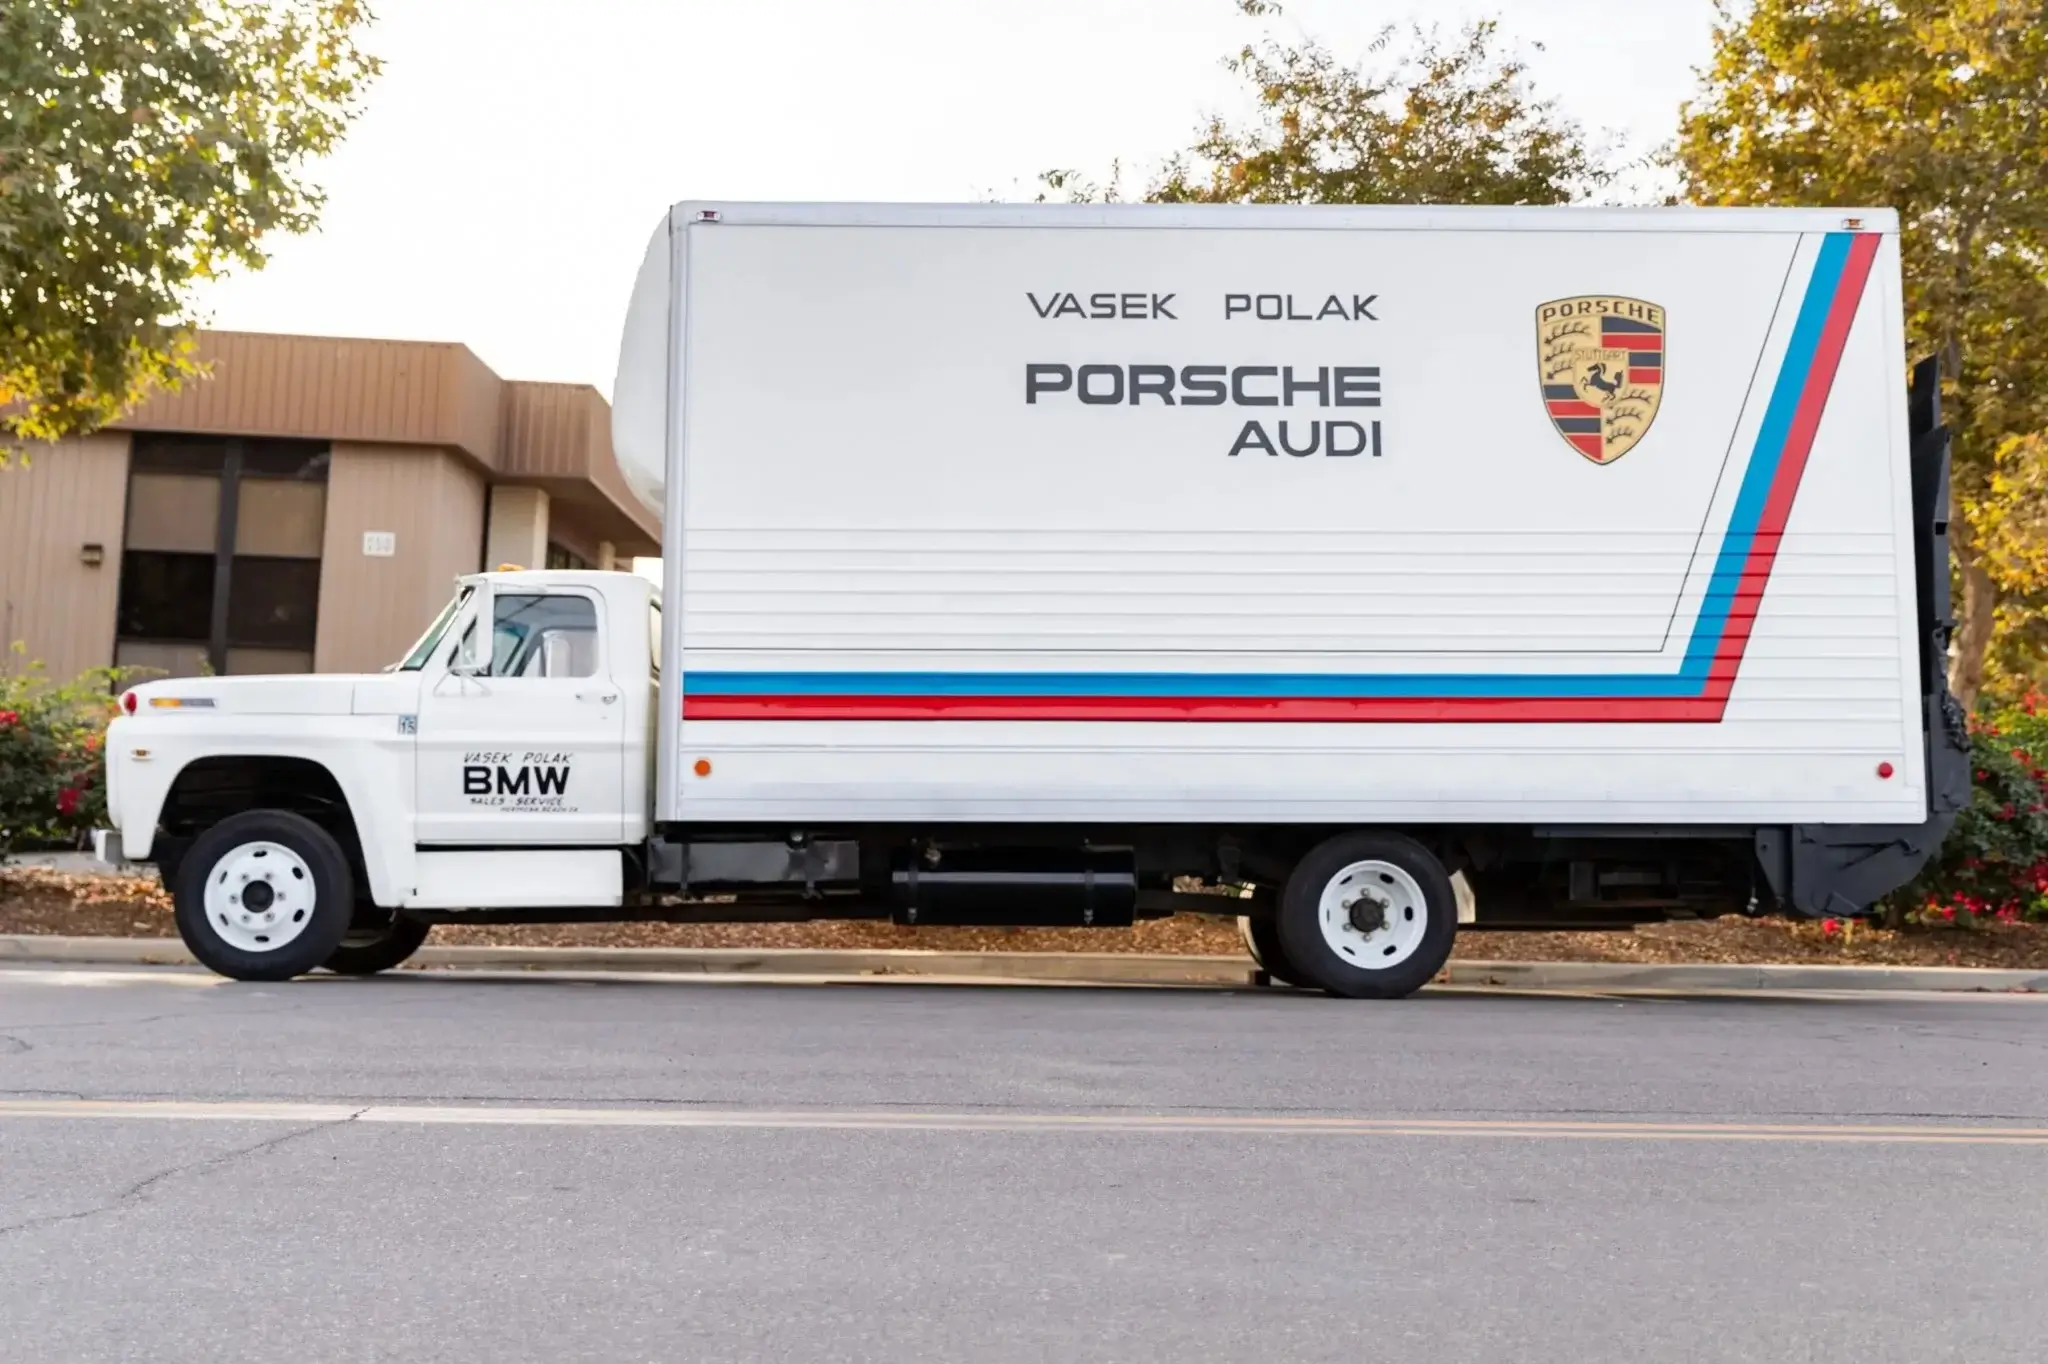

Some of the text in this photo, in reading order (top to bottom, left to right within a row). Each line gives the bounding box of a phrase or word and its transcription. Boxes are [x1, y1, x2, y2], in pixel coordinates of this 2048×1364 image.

[1026, 292, 1379, 320] VASEK POLAK
[1543, 300, 1660, 324] PORSCHE
[1026, 364, 1381, 407] PORSCHE
[1228, 420, 1382, 457] AUDI
[464, 752, 573, 764] VASEK POLAK
[464, 766, 570, 795] BMW
[470, 797, 563, 806] SALES SERVICE
